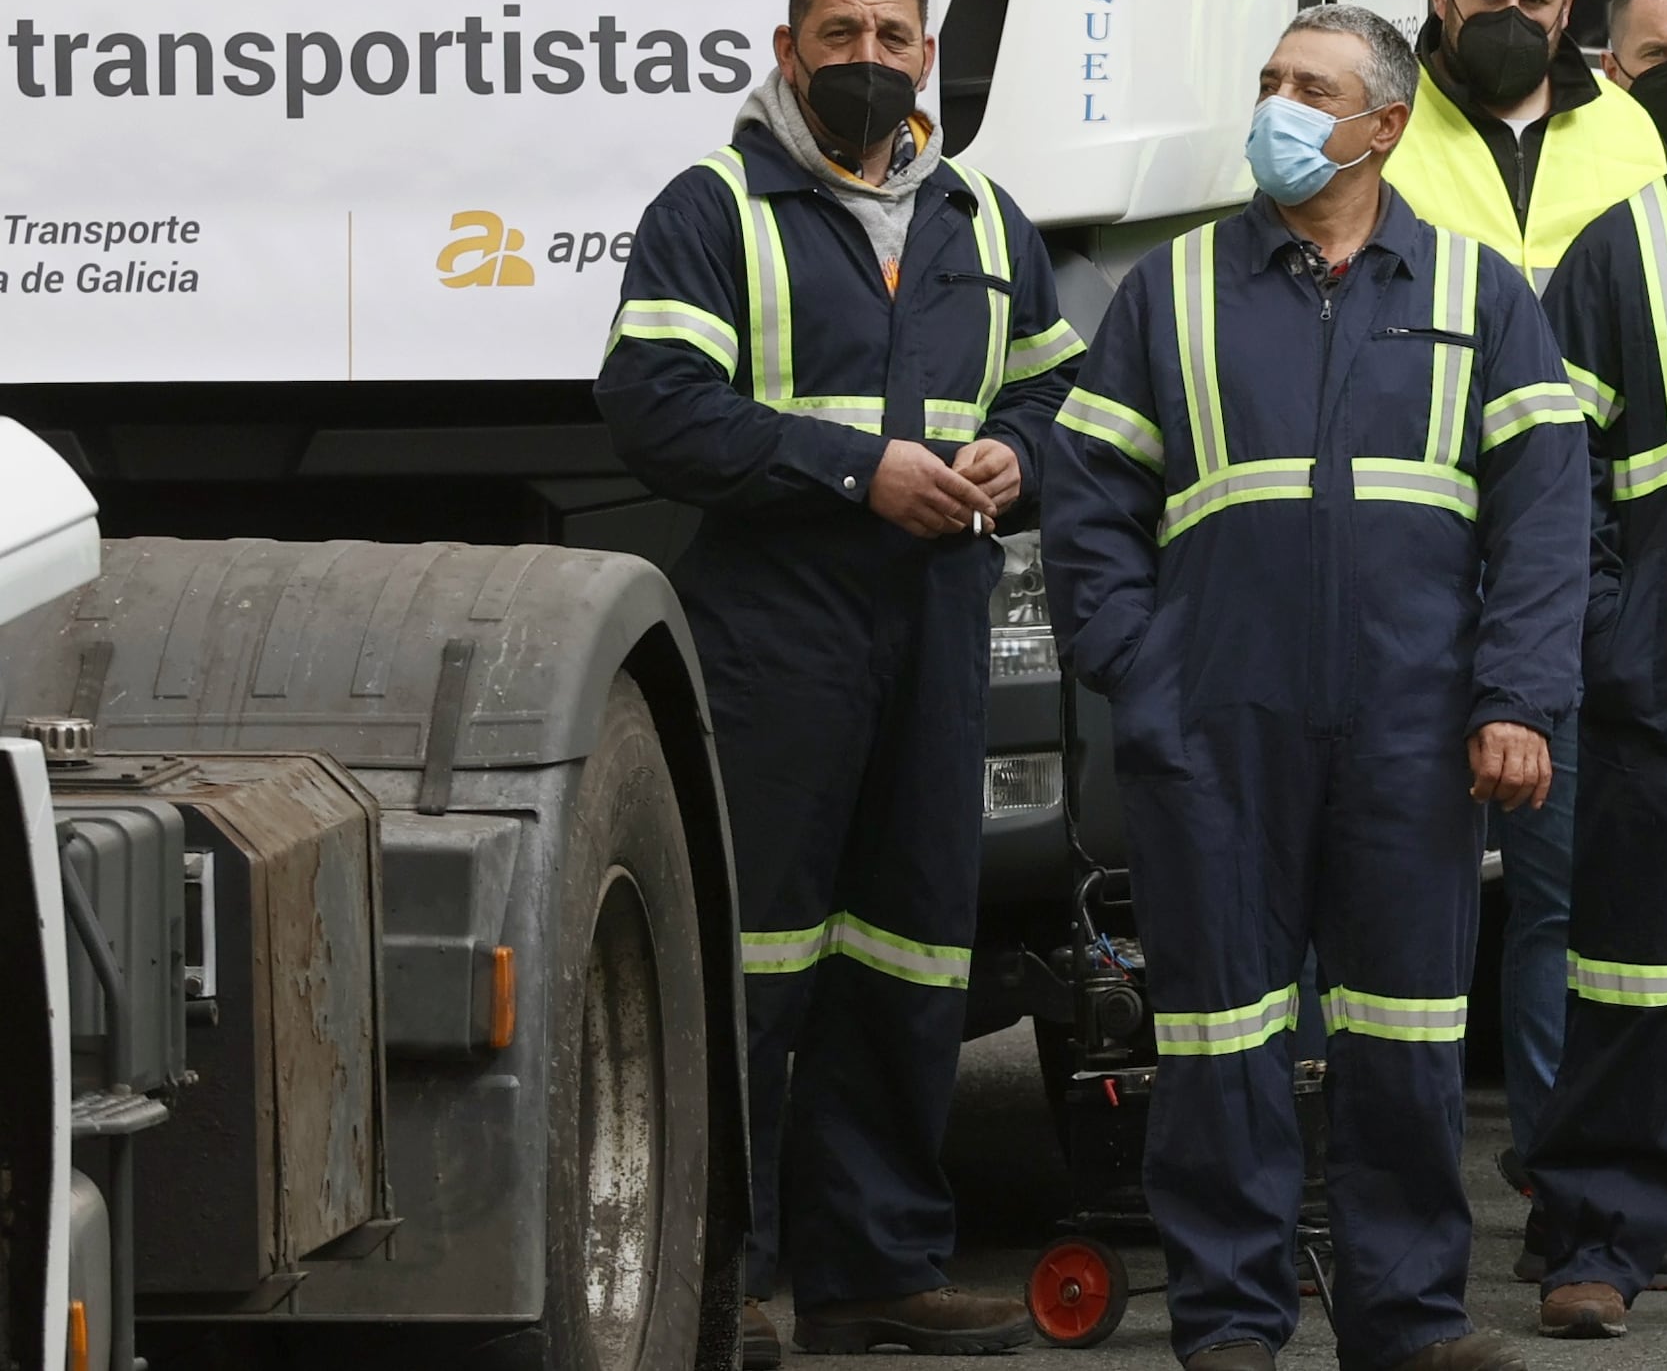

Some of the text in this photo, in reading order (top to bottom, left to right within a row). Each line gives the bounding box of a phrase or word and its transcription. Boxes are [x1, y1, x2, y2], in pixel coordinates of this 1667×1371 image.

[7, 3, 753, 120] transportistas
[4, 214, 201, 252] Transporte
[21, 261, 65, 294] de
[76, 260, 200, 294] Galicia
